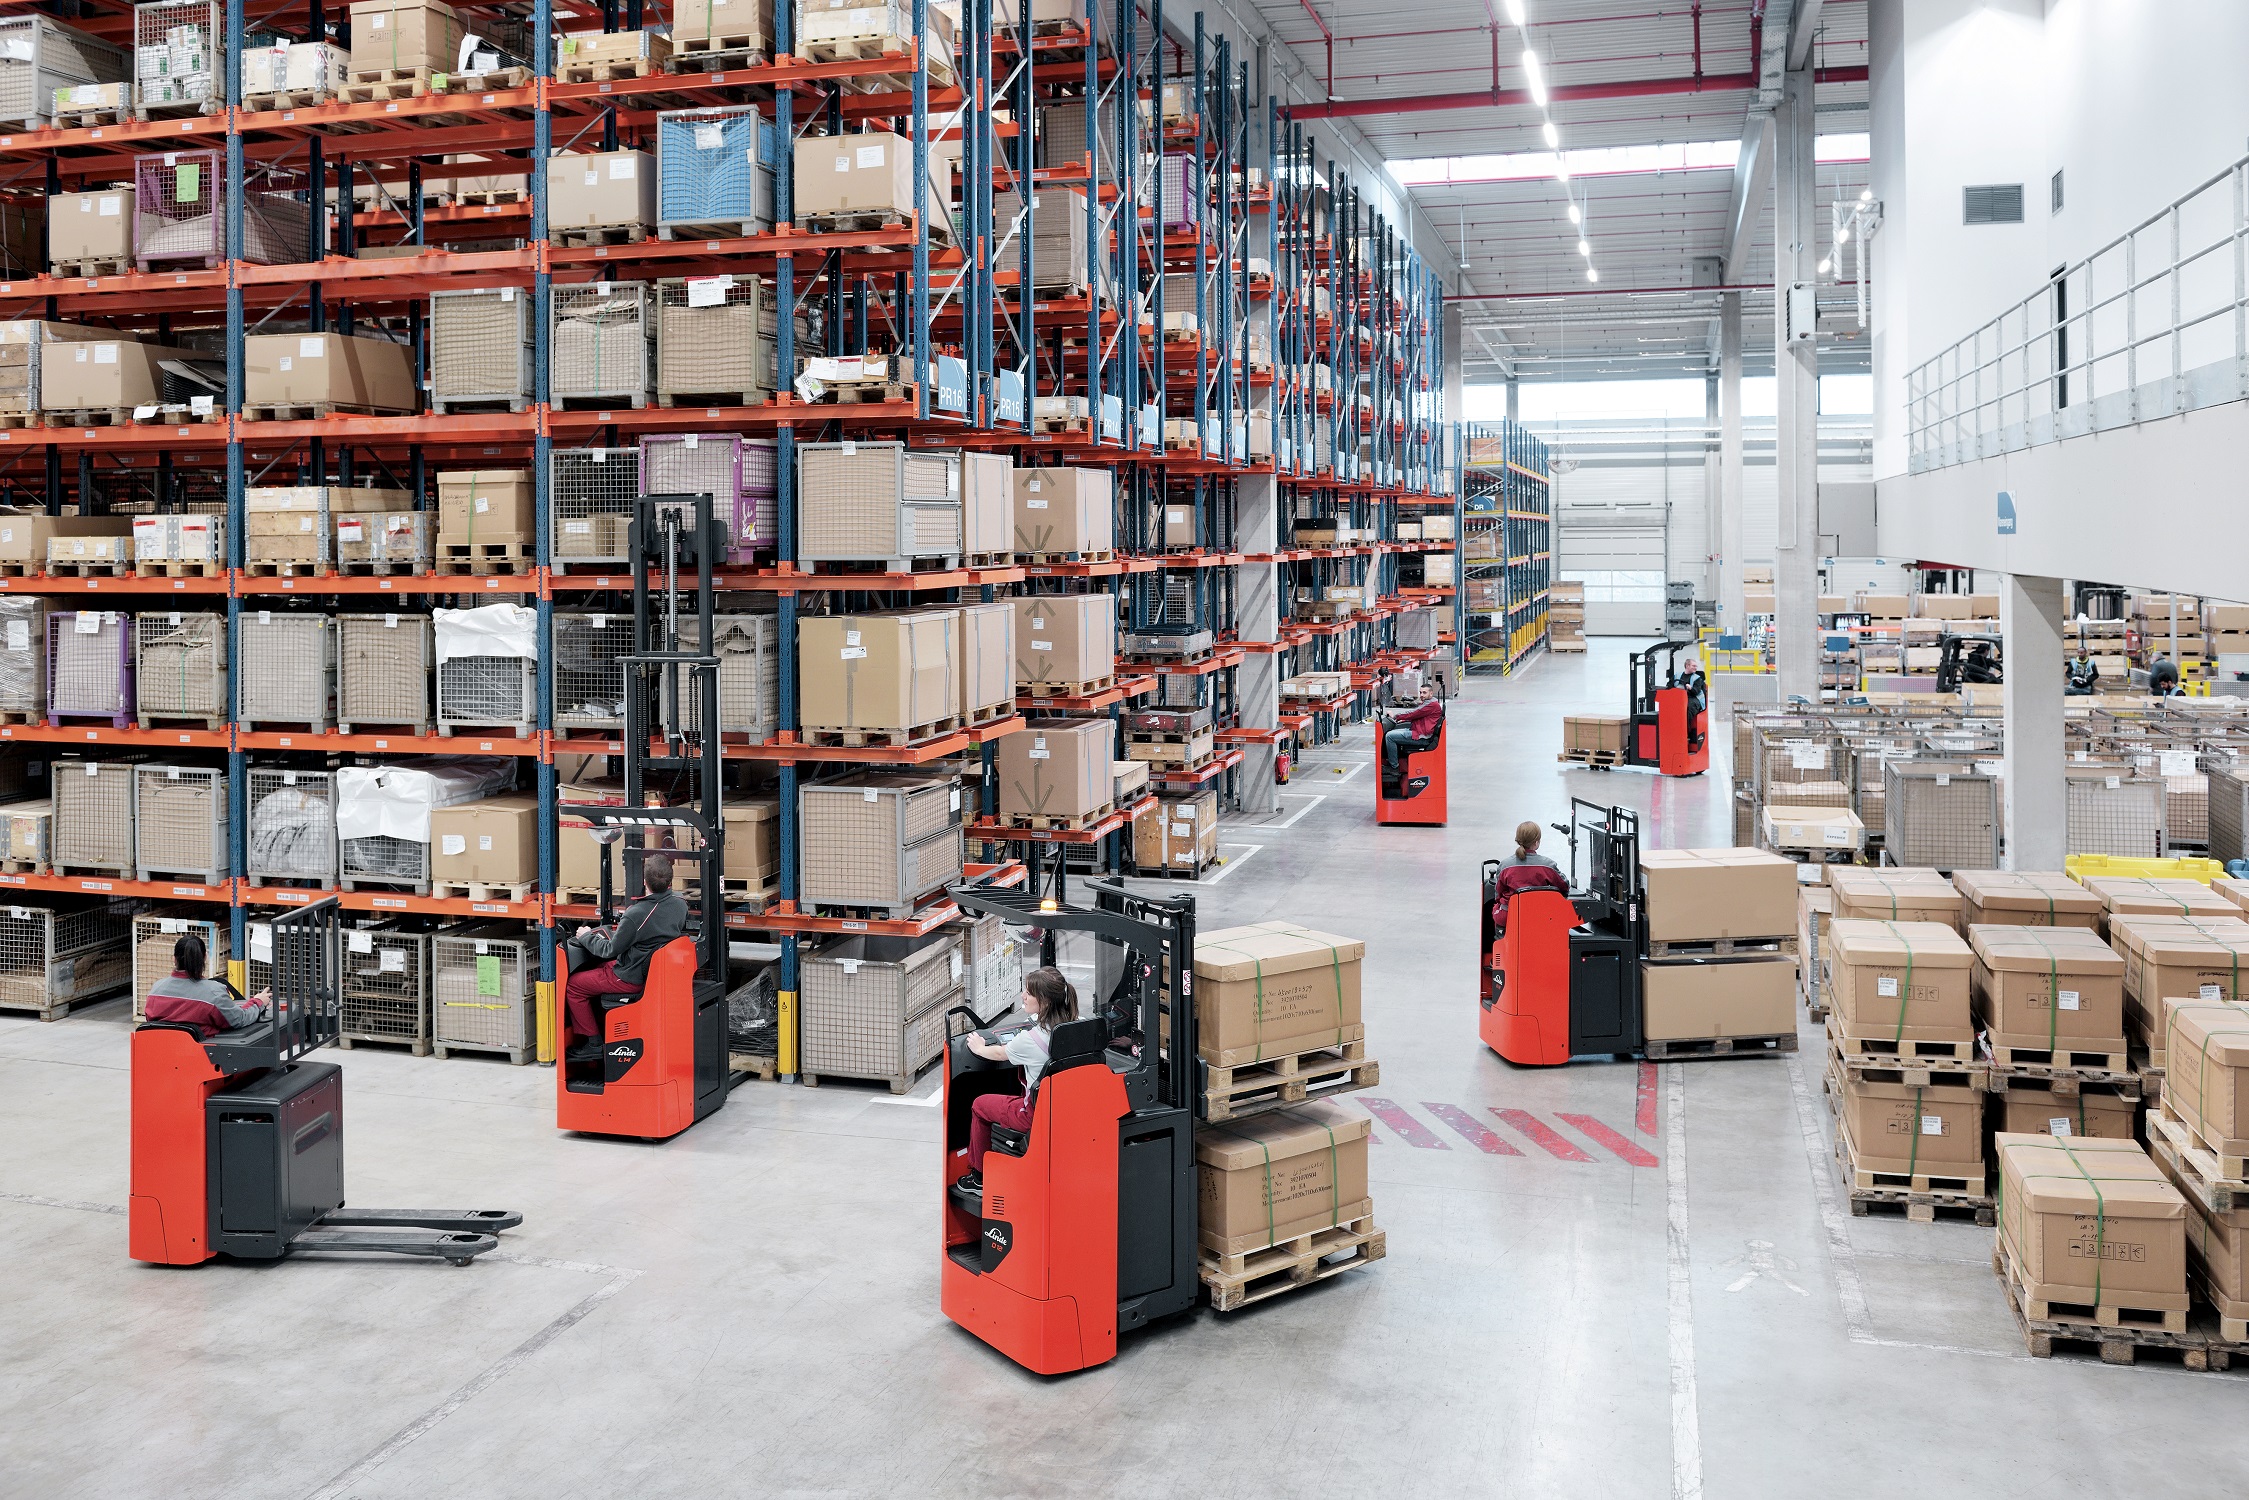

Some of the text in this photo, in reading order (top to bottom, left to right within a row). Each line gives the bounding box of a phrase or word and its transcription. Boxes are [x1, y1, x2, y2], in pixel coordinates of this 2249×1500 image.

[940, 386, 963, 408] PR16
[1001, 397, 1020, 418] PR15
[1104, 417, 1119, 436] PR14
[608, 1046, 637, 1056] Linde
[984, 1227, 1007, 1246] Linde
